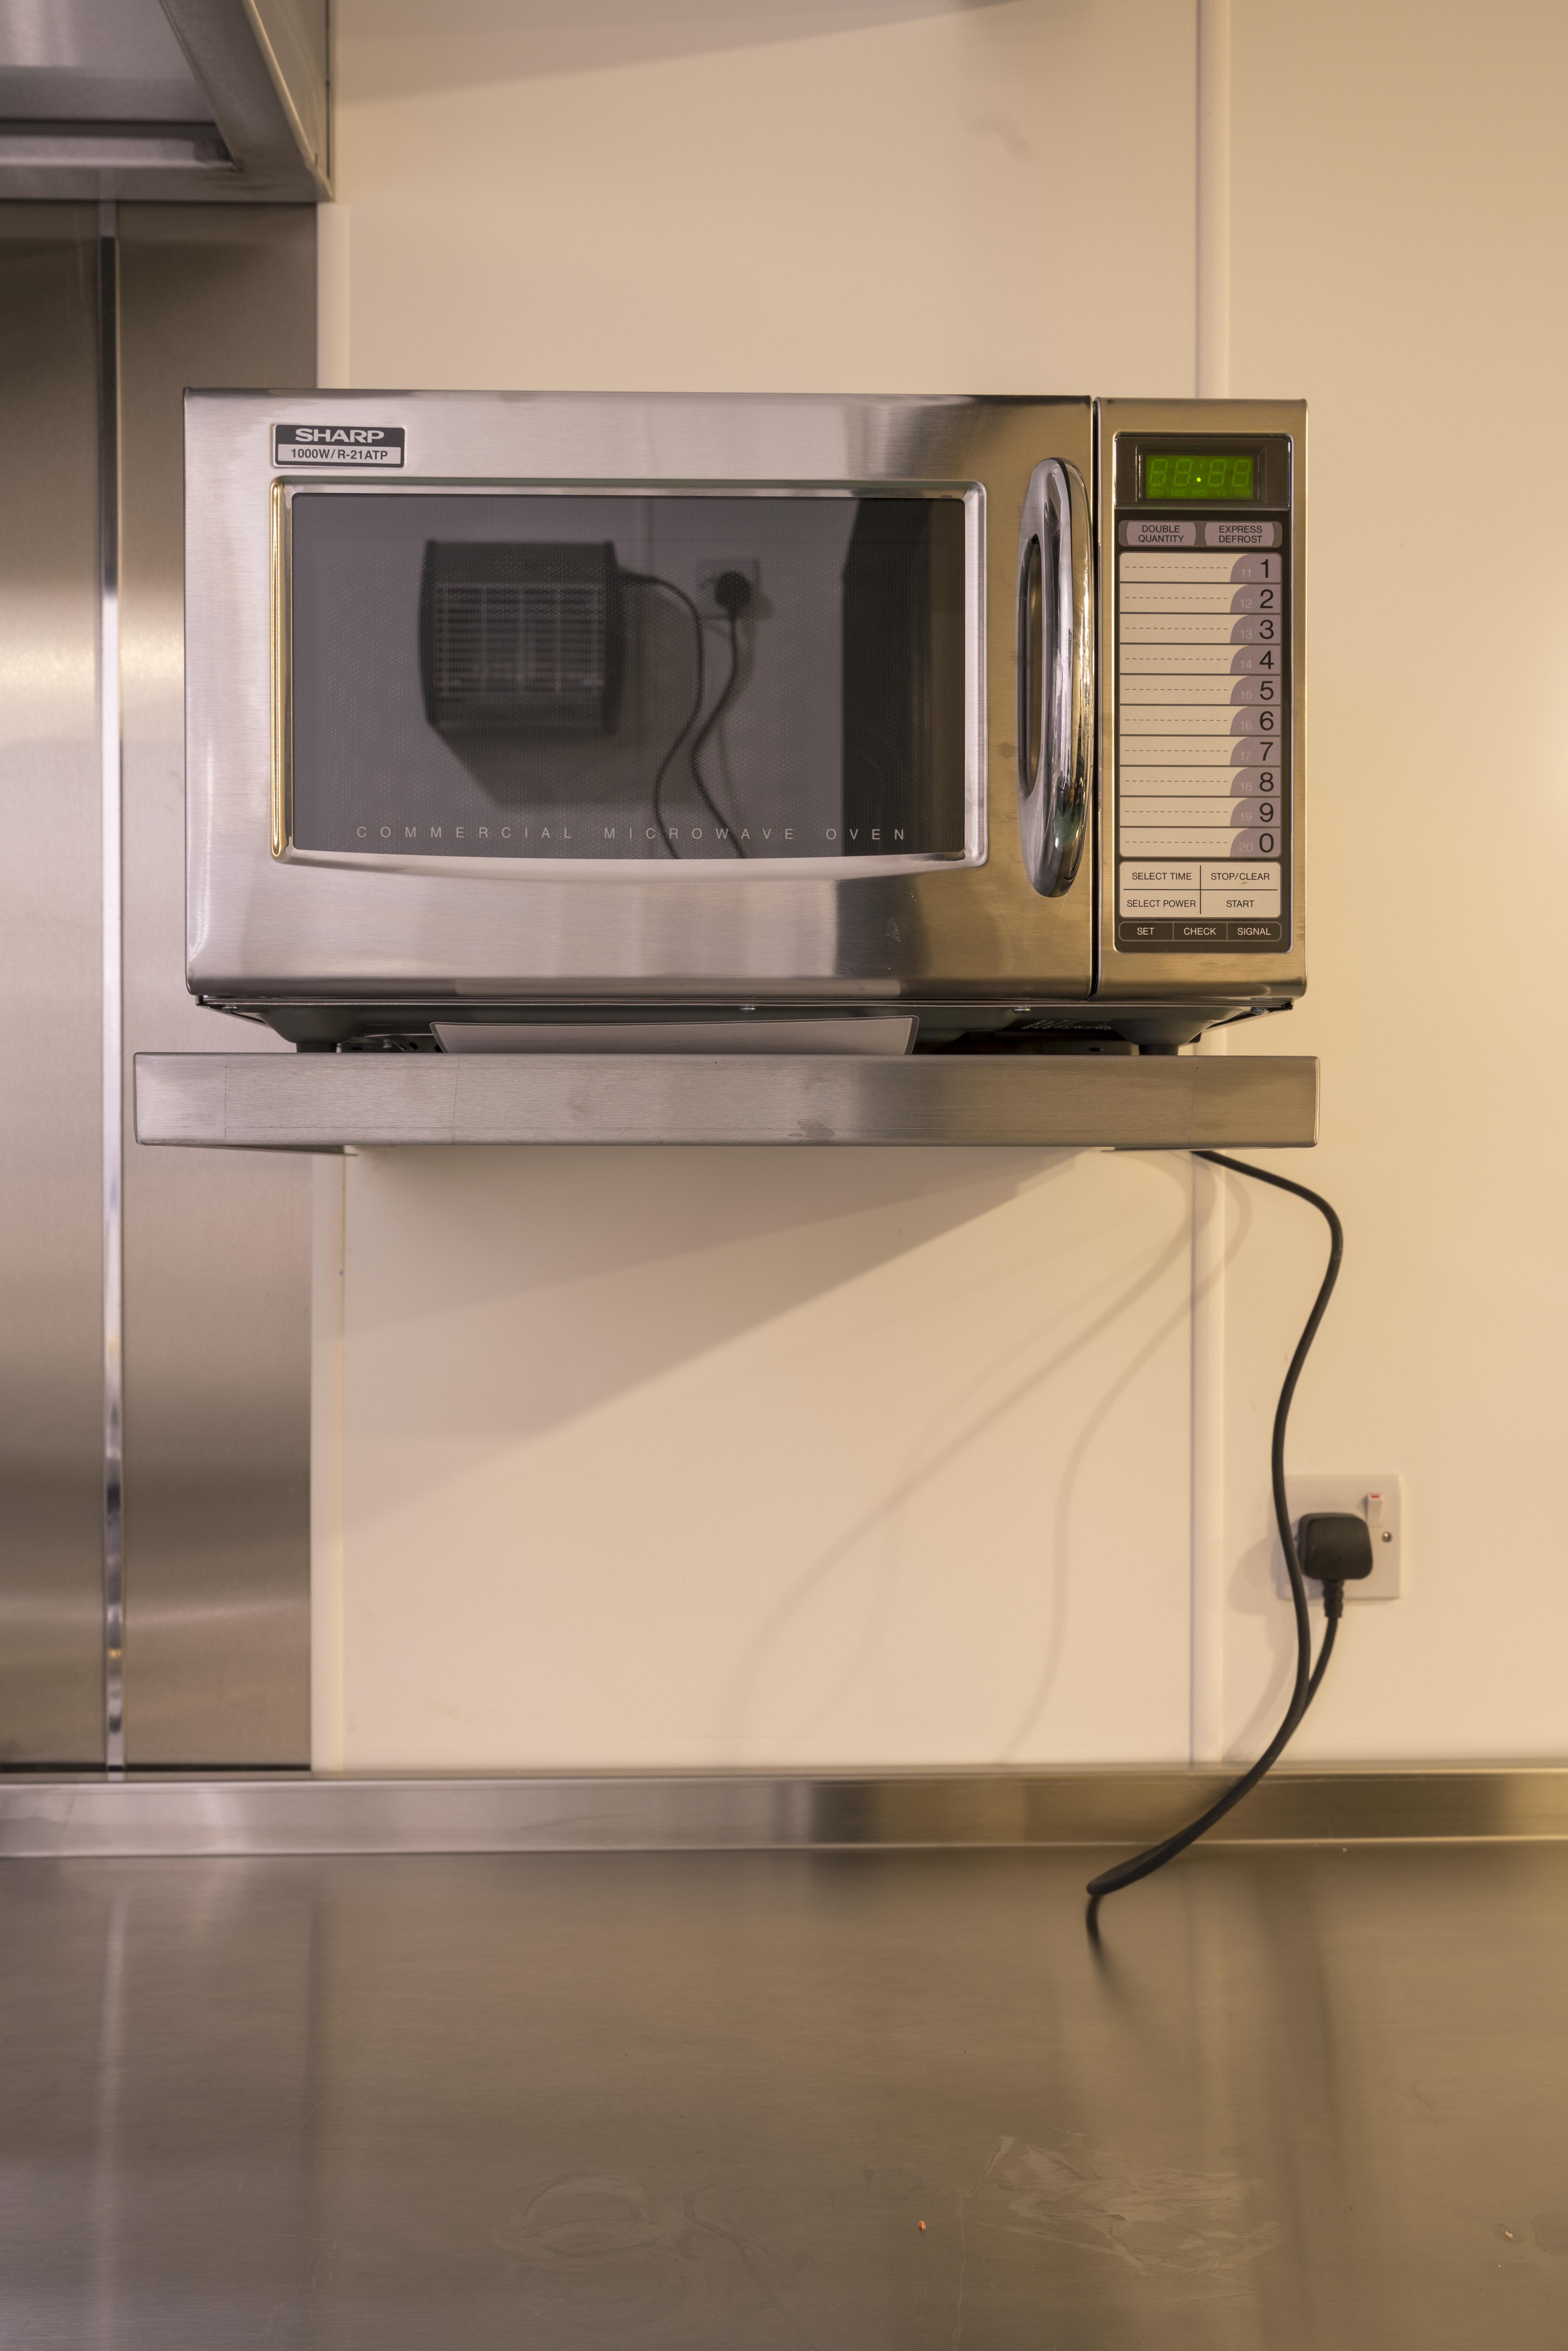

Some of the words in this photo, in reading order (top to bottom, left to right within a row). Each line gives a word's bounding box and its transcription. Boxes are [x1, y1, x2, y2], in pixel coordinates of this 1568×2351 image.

[295, 428, 384, 443] SHARP
[291, 448, 388, 460] 1000W/R-21ATP
[1142, 525, 1180, 533] DOUBLE
[1219, 525, 1262, 533] EXPRESS
[1138, 535, 1184, 543] QUANTITY
[1219, 535, 1262, 543] DEFROST
[1241, 568, 1251, 578] 11
[1261, 559, 1269, 578] 1
[1240, 599, 1252, 608] 12
[1260, 589, 1274, 609] 2
[1240, 629, 1252, 639] 13
[1259, 619, 1274, 639] 3
[1240, 660, 1252, 669] 14
[1259, 650, 1274, 669] 4
[1240, 690, 1252, 700] 15
[1259, 680, 1274, 700] 5
[1240, 721, 1252, 730] 16
[1259, 711, 1274, 731] 6
[1240, 751, 1252, 761] 17
[1260, 741, 1273, 761] 7
[1240, 782, 1252, 791] 18
[1259, 772, 1274, 792] 8
[1240, 812, 1252, 822] 19
[1259, 802, 1274, 822] 9
[357, 826, 572, 839] COMMERCIAL
[604, 828, 793, 840] MICROWAVE
[826, 828, 904, 840] OVEN
[1239, 843, 1253, 852] 20
[1259, 833, 1274, 853] 0
[1132, 872, 1167, 880] SELECT
[1170, 872, 1192, 880] TIME
[1163, 900, 1196, 908] POWER
[1137, 927, 1155, 935] SET
